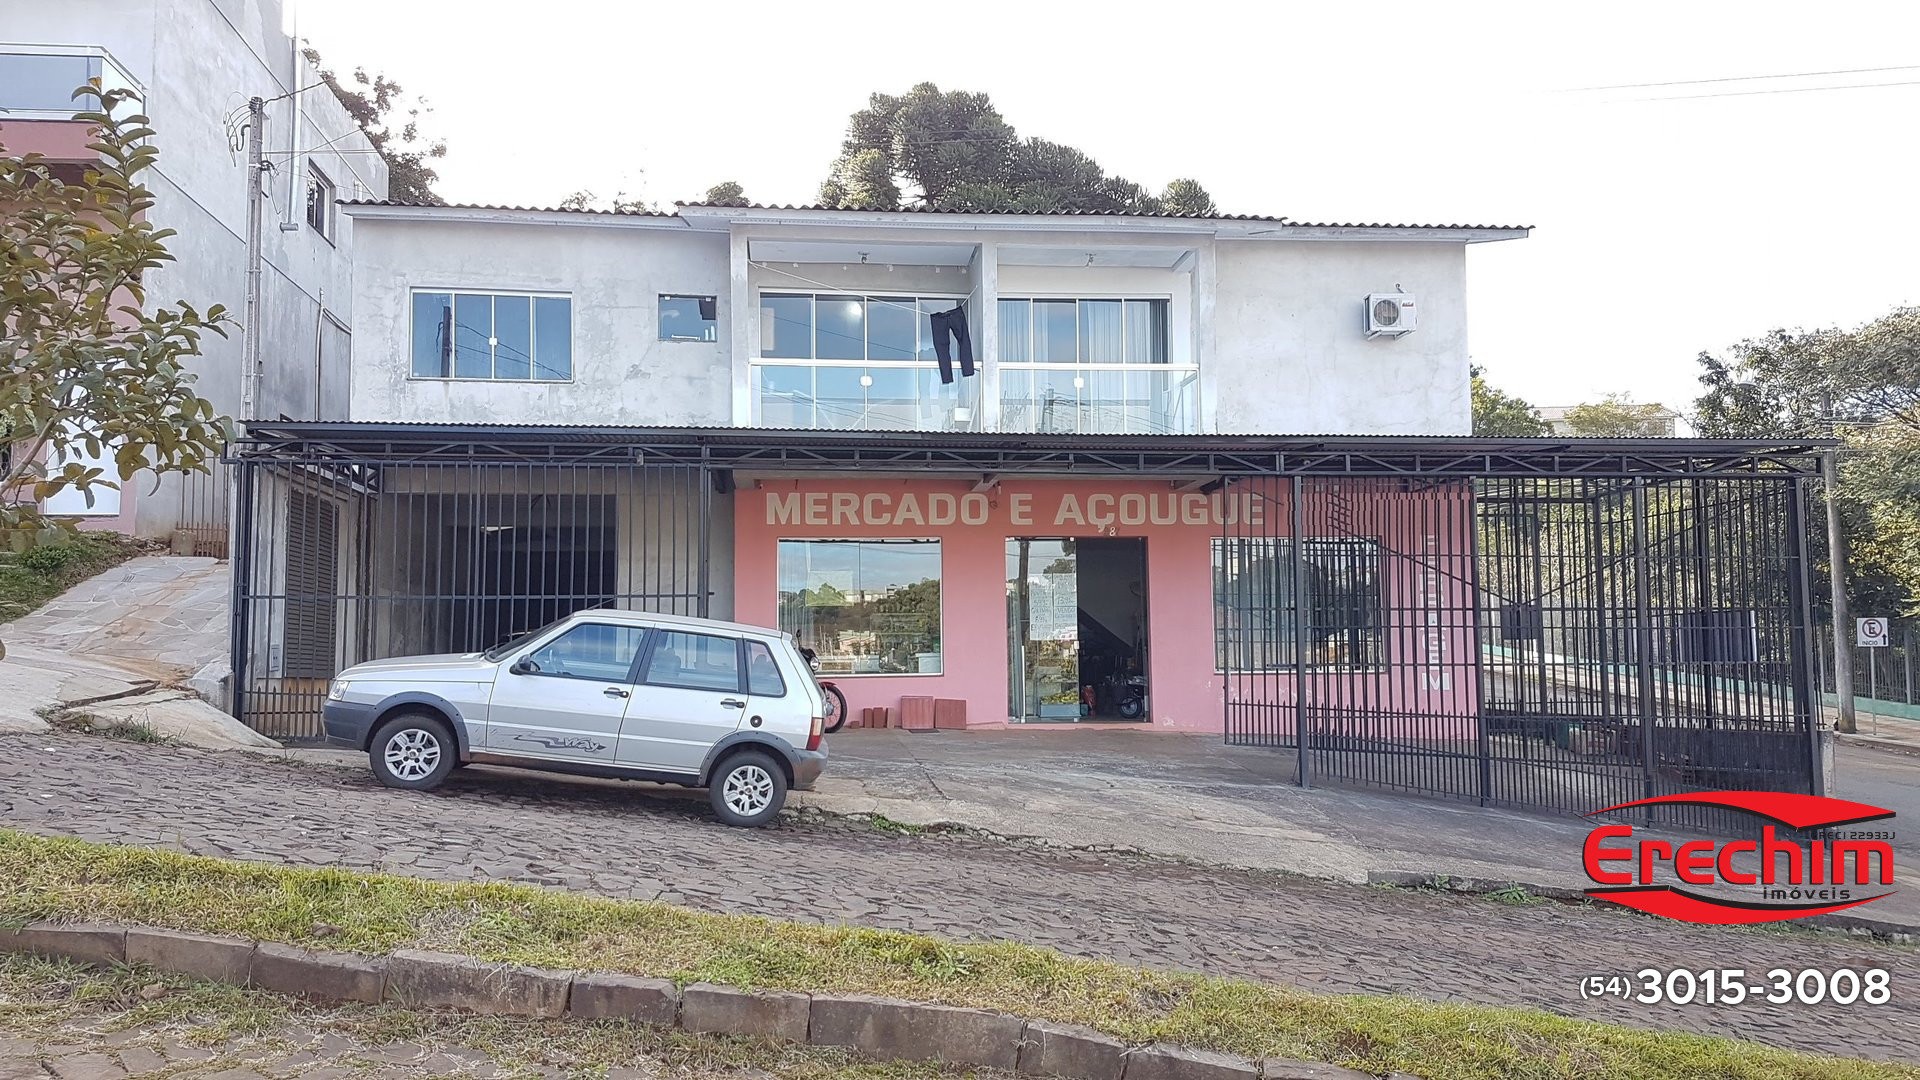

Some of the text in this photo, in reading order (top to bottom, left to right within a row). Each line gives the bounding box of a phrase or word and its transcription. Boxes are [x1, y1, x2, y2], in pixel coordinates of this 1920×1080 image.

[766, 492, 1264, 533] MERCADO E AÇOUGUE
